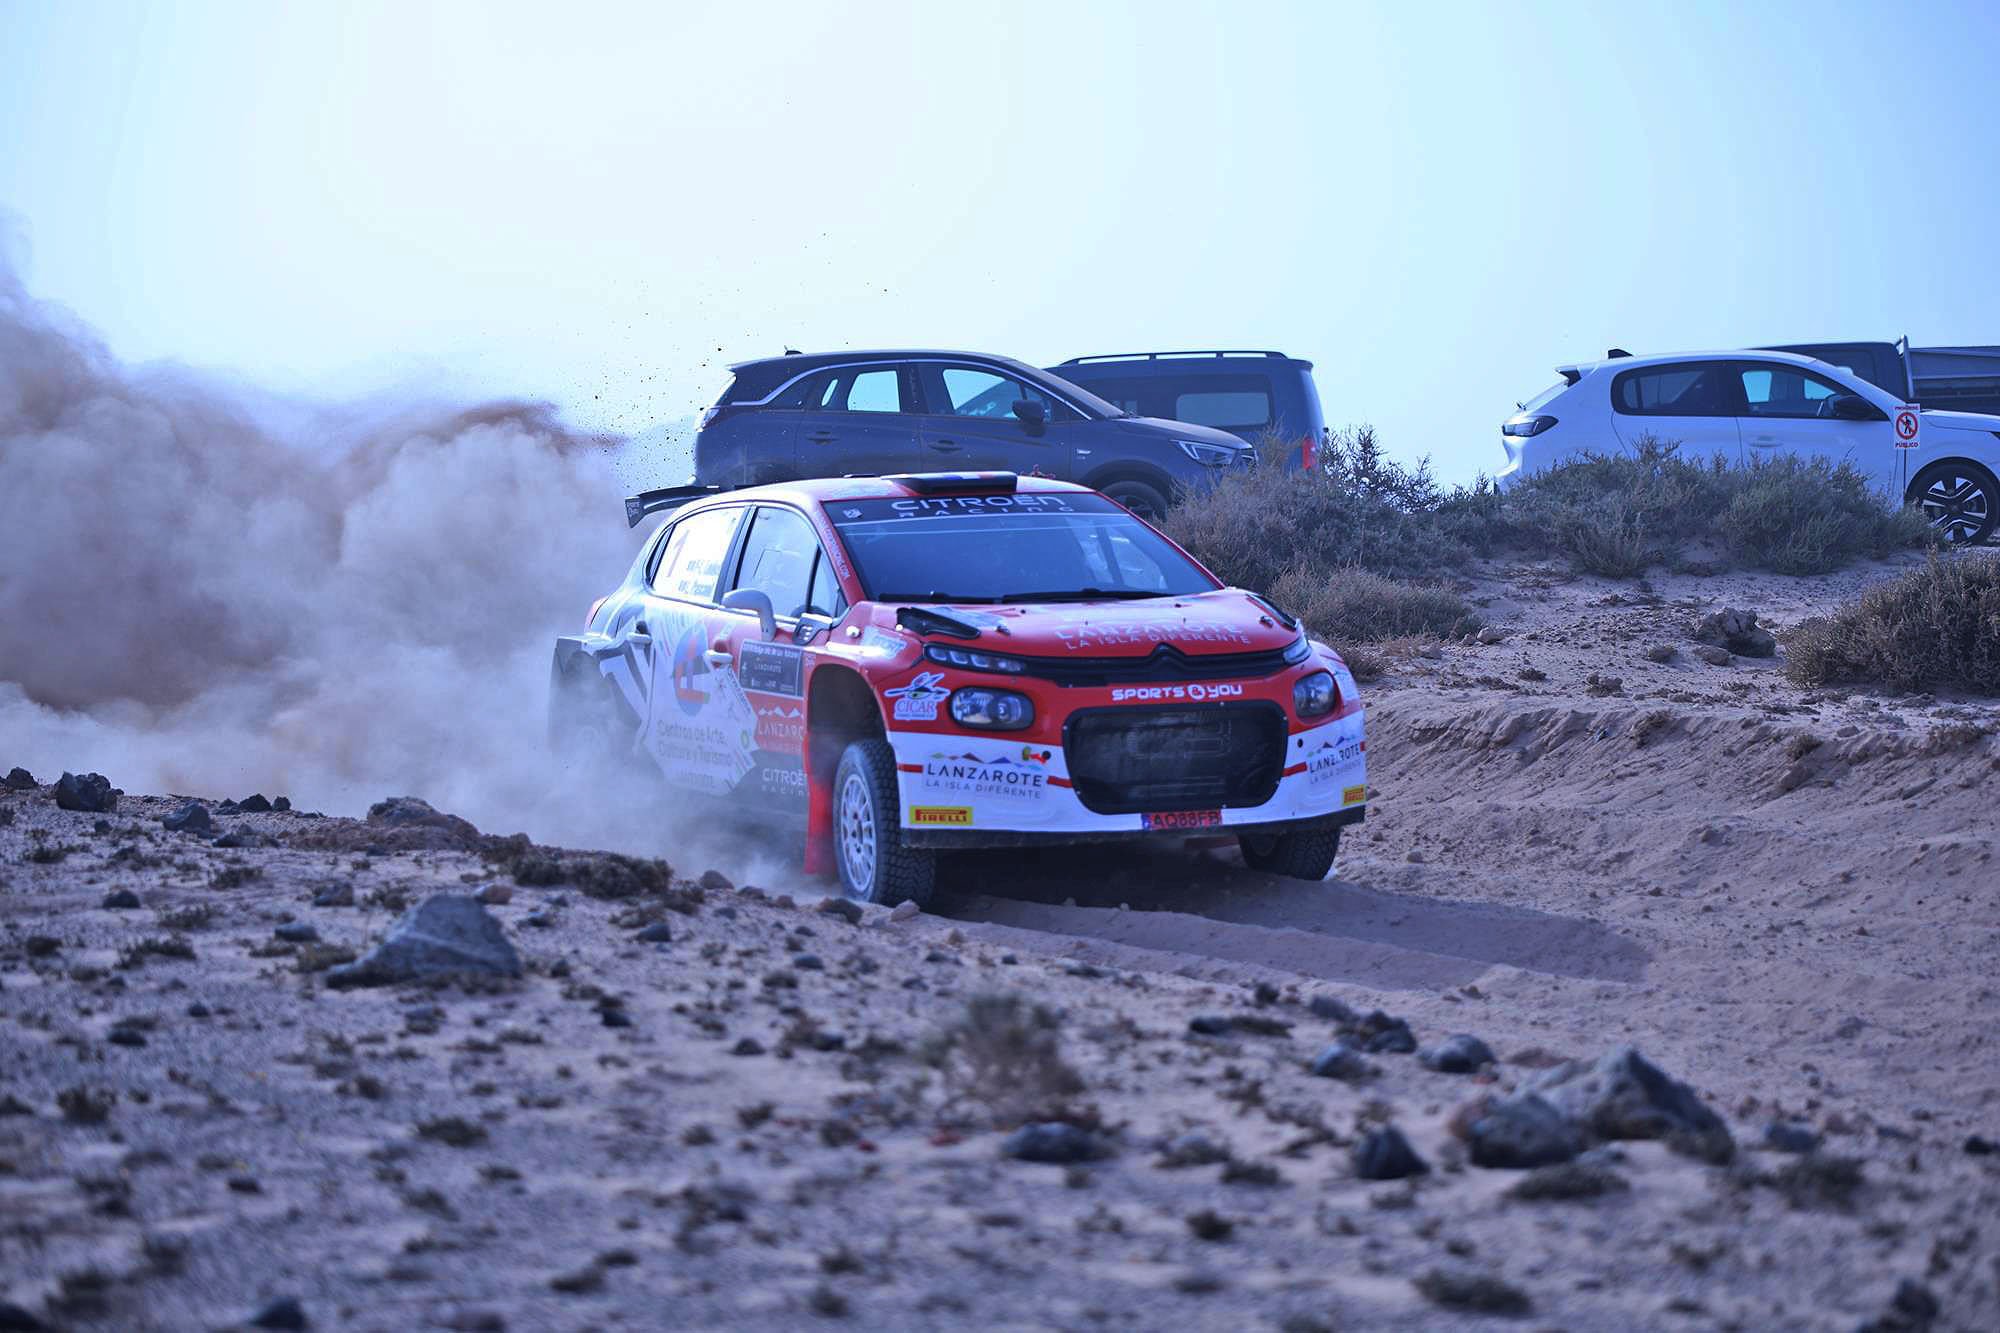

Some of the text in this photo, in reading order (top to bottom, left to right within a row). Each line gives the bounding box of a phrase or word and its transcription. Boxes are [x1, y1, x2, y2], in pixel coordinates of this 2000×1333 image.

[891, 494, 1066, 510] CITROËN
[1065, 639, 1091, 650] LA
[1099, 635, 1141, 646] ISLA
[1111, 686, 1186, 701] SPORTS
[896, 700, 936, 712] CICAR
[927, 763, 1043, 788] LANZAROTE
[926, 780, 1042, 799] LA ISLA DIFERENTE
[914, 809, 968, 823] PIRELLI
